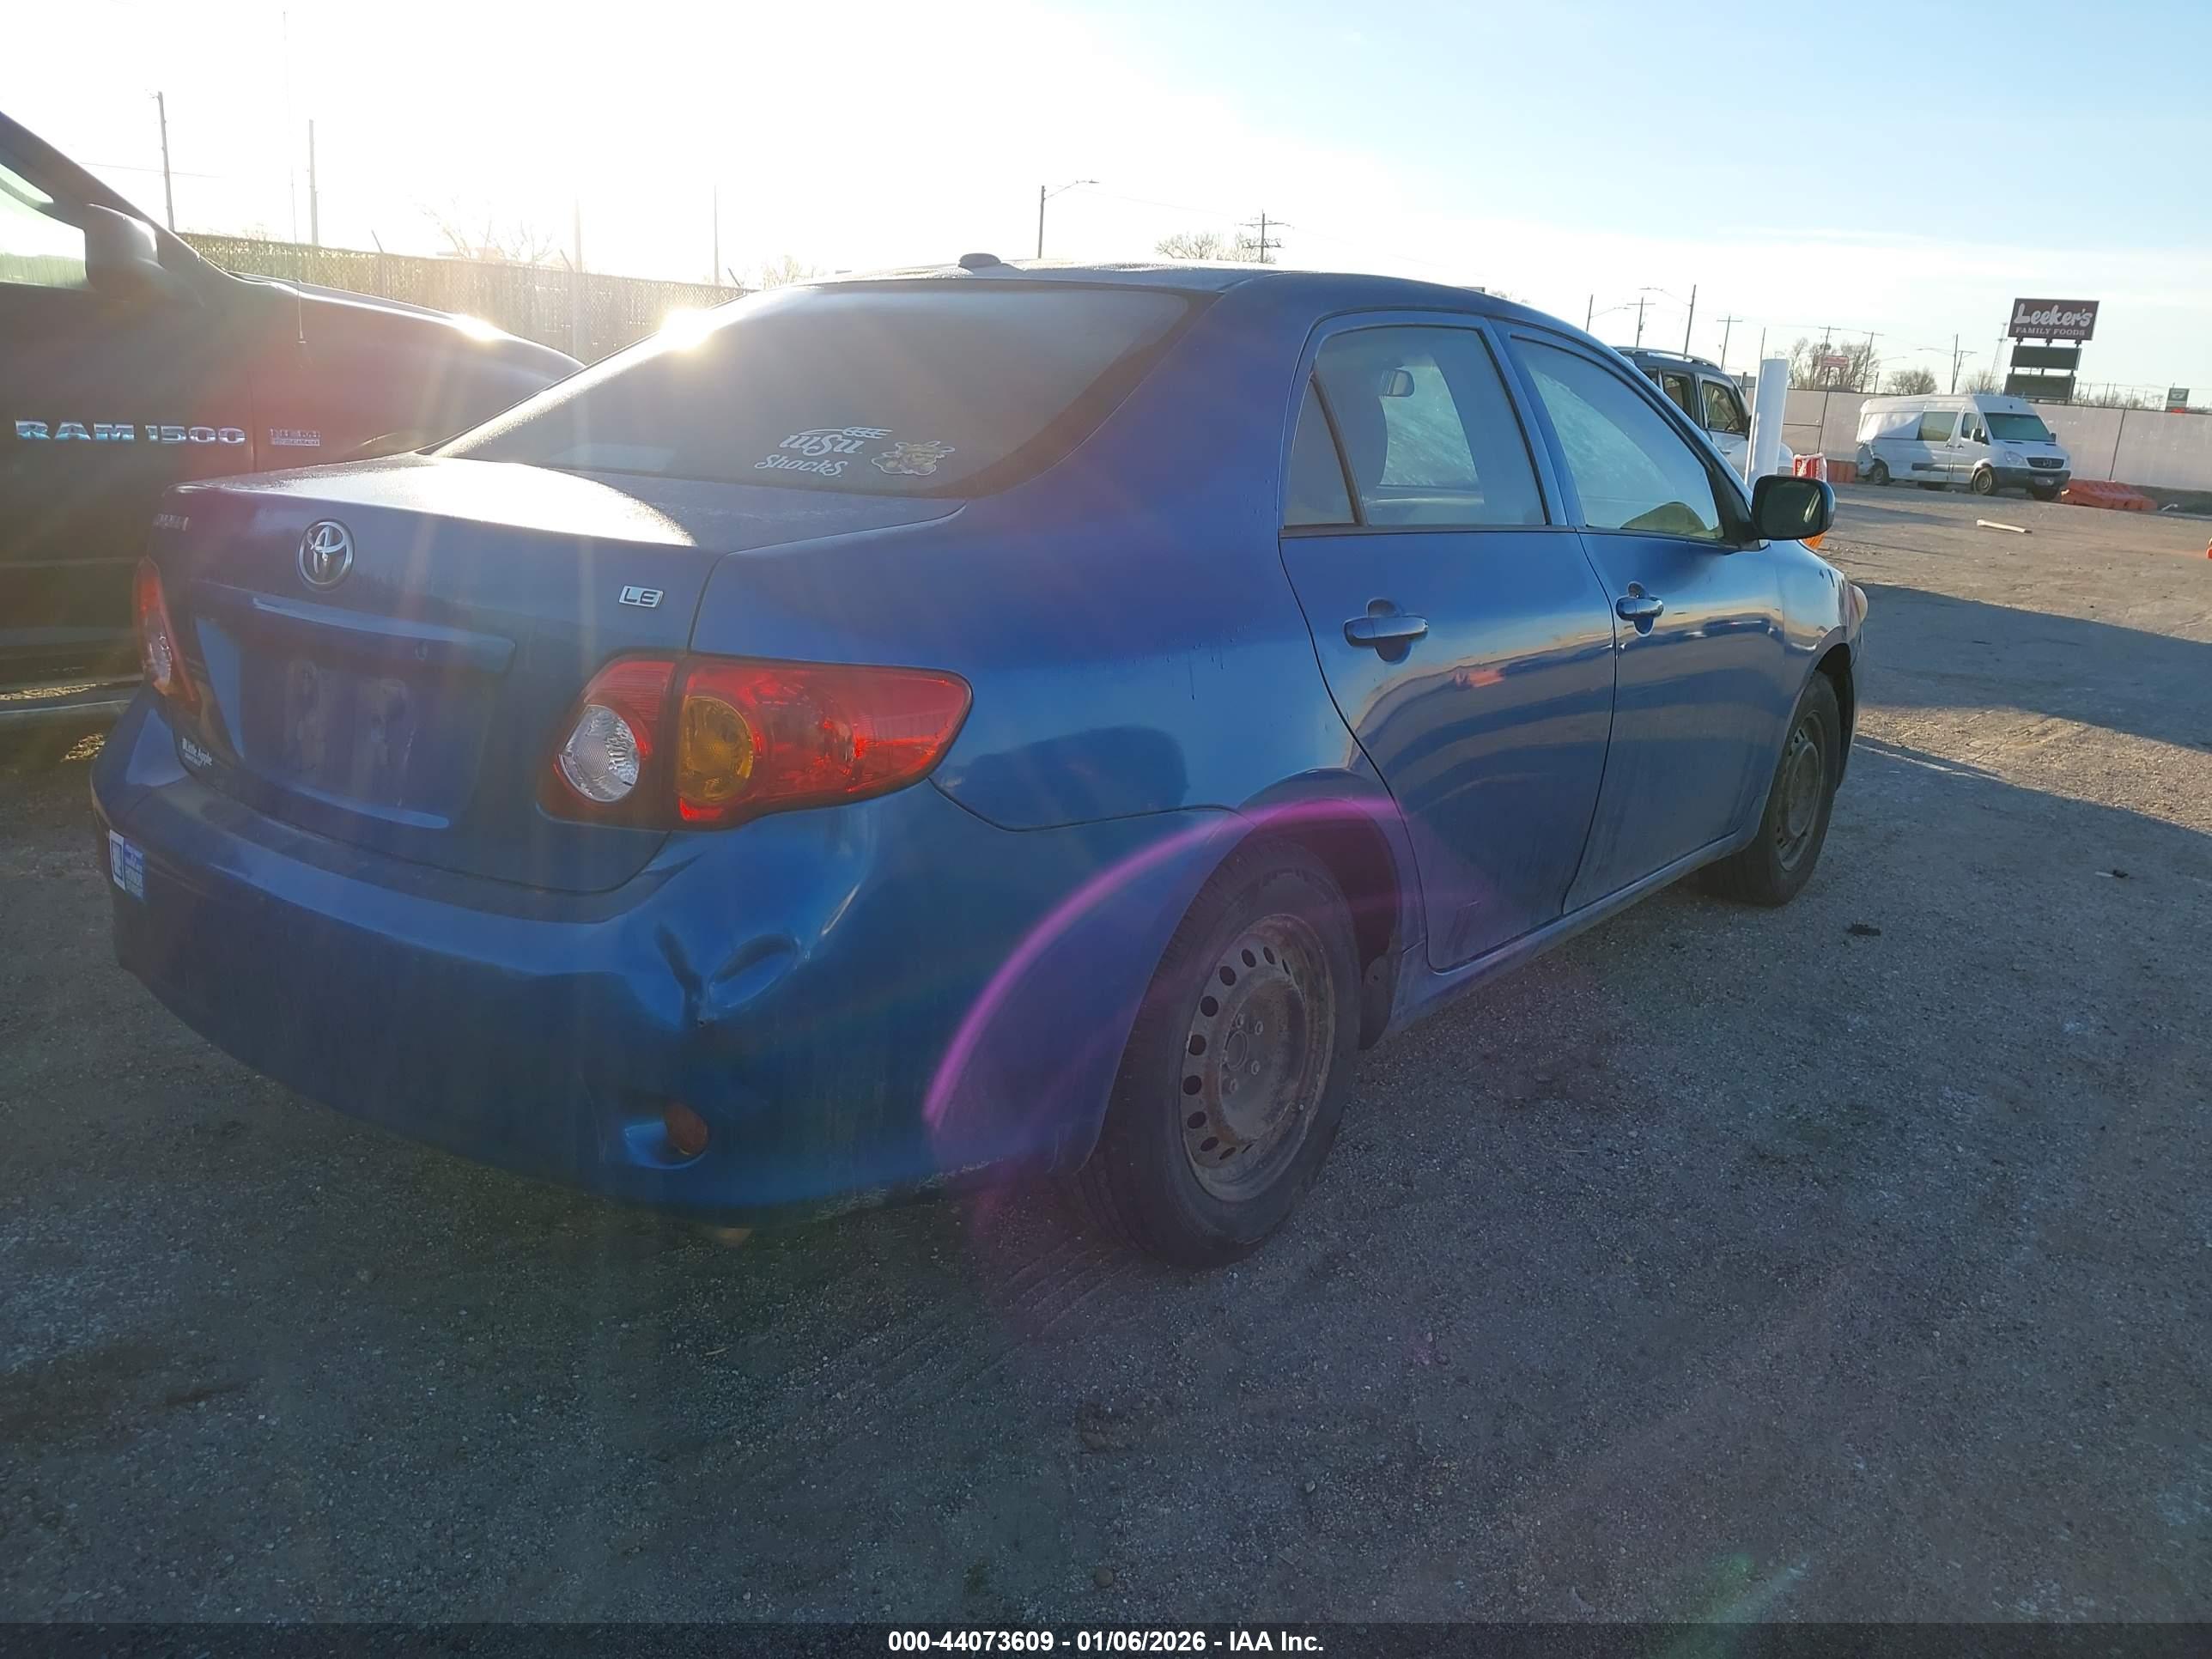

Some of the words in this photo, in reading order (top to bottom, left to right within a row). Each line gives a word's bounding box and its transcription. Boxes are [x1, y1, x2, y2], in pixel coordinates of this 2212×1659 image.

[2013, 302, 2094, 327] Leeker's
[2015, 326, 2051, 336] FAMILY
[2052, 328, 2086, 337] FOODS
[15, 420, 136, 441] RAM
[145, 424, 246, 444] 1500
[623, 587, 658, 605] LE
